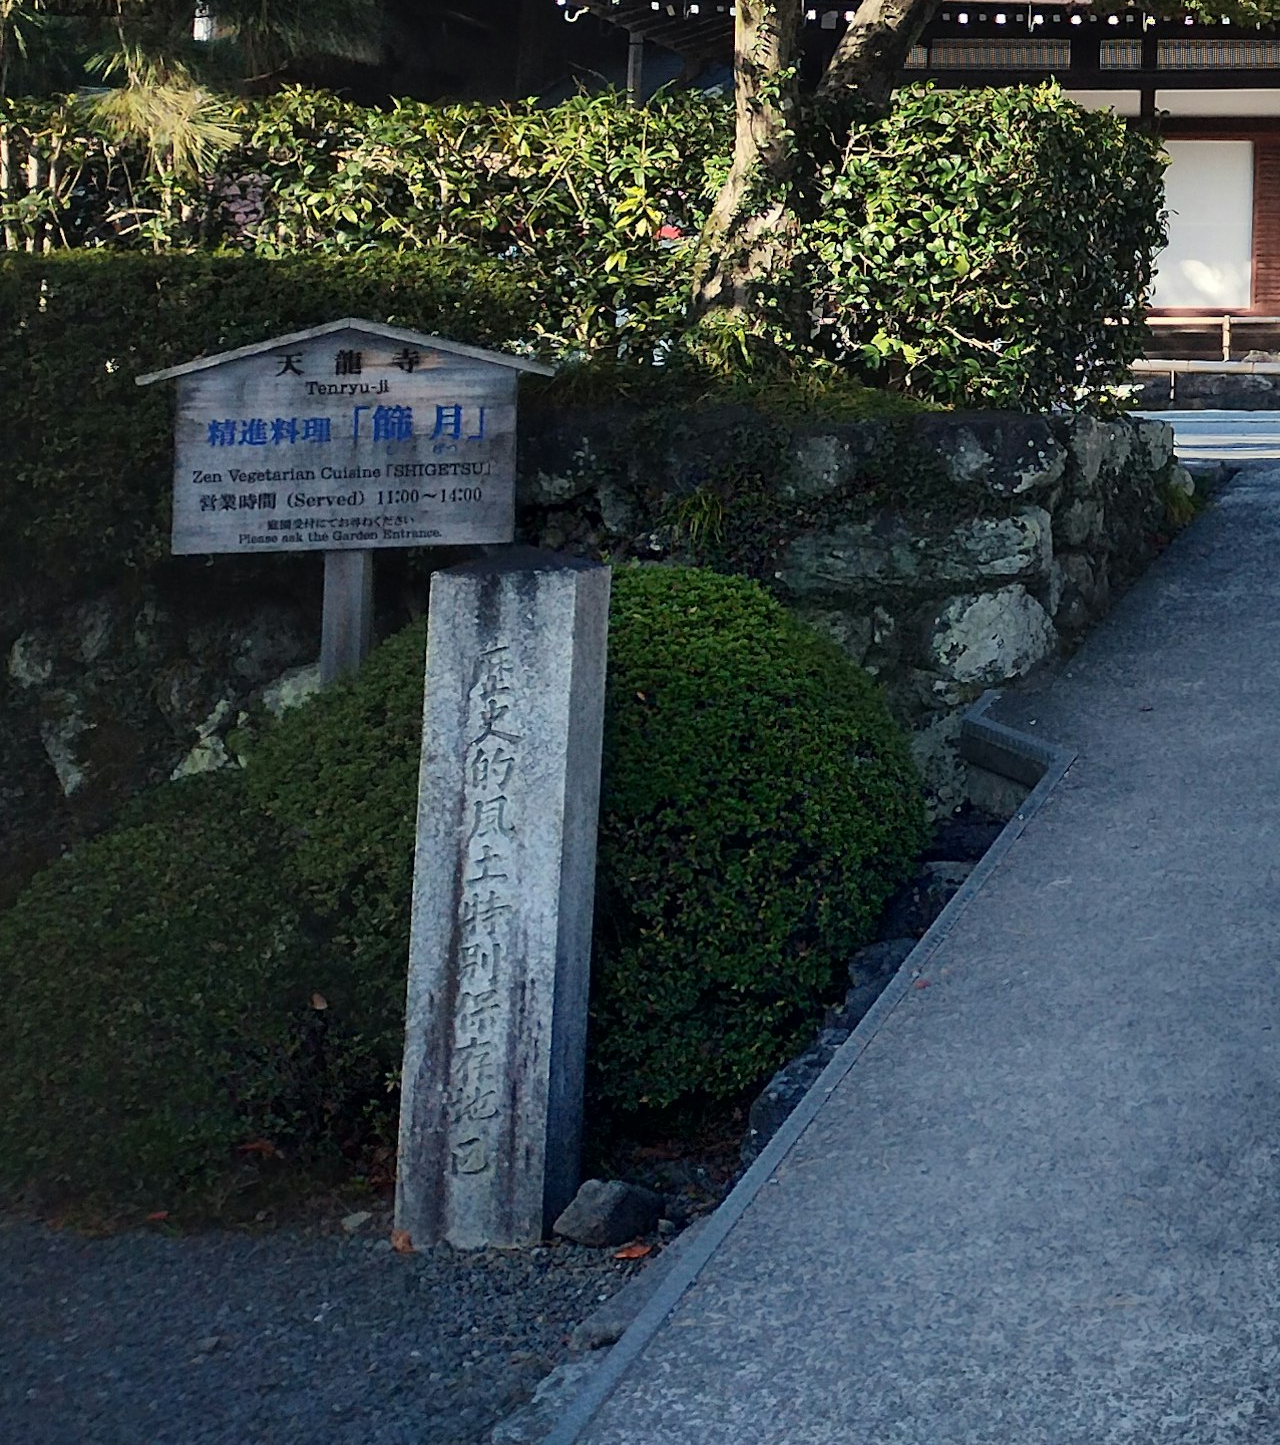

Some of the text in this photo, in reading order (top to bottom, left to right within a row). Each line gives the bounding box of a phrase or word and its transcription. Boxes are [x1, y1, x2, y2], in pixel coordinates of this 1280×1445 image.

[276, 348, 421, 377] 天龍寺
[305, 379, 389, 396] Tenryu-ji
[192, 470, 223, 484] Zen
[227, 467, 317, 484] Vegetarian
[320, 465, 381, 481] Cuisine
[200, 492, 277, 512] 営業時間
[239, 528, 442, 544] Please ask the Garden Entrance.
[450, 645, 525, 1175] 歴史的風土特別保存地区
